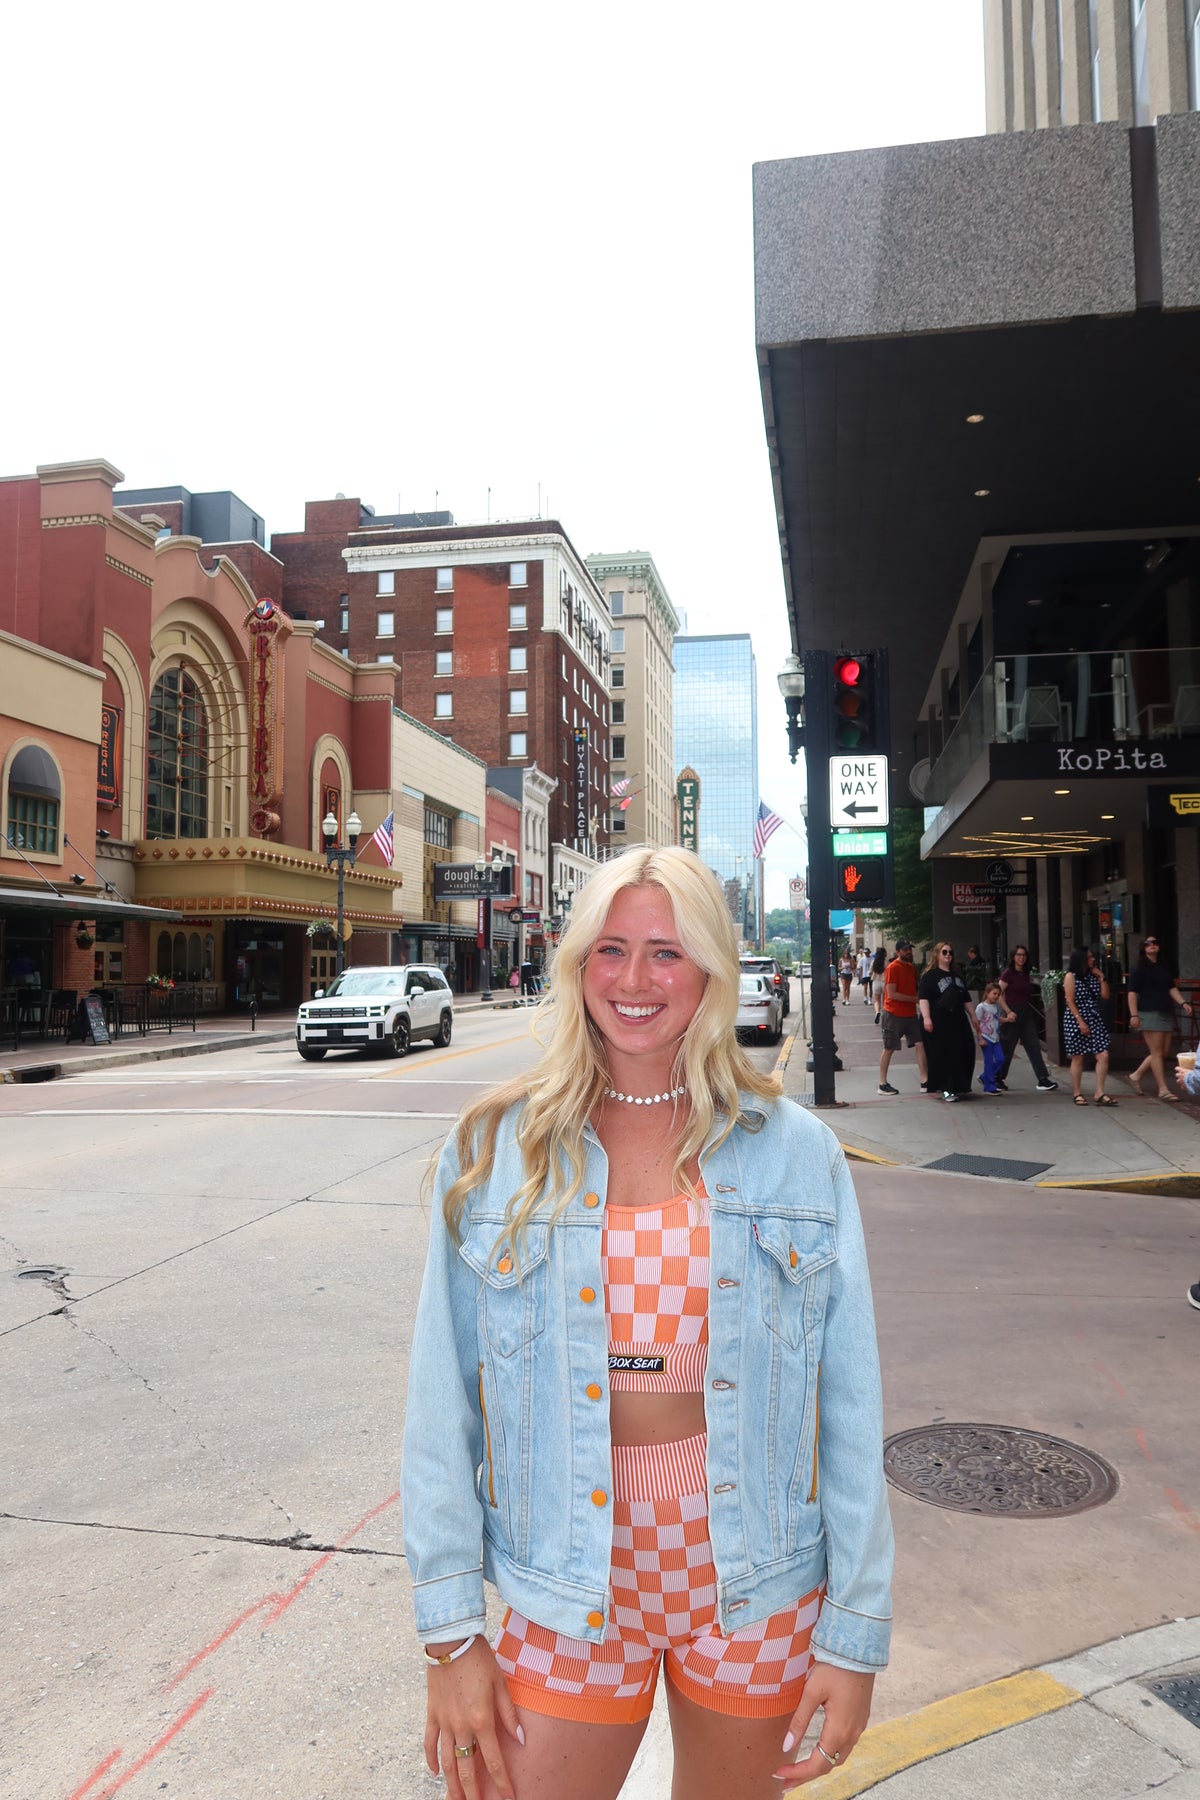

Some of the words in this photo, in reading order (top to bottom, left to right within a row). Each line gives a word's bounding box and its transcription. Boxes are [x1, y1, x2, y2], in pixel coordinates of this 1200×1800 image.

[254, 635, 270, 797] RIVIERA
[101, 730, 109, 777] REGAL
[1057, 747, 1167, 771] KoPita
[577, 744, 586, 788] HYATT
[841, 763, 877, 777] ONE
[840, 781, 878, 795] WAY
[577, 792, 586, 838] PLACE
[836, 841, 870, 854] Union
[608, 1356, 632, 1368] BOX
